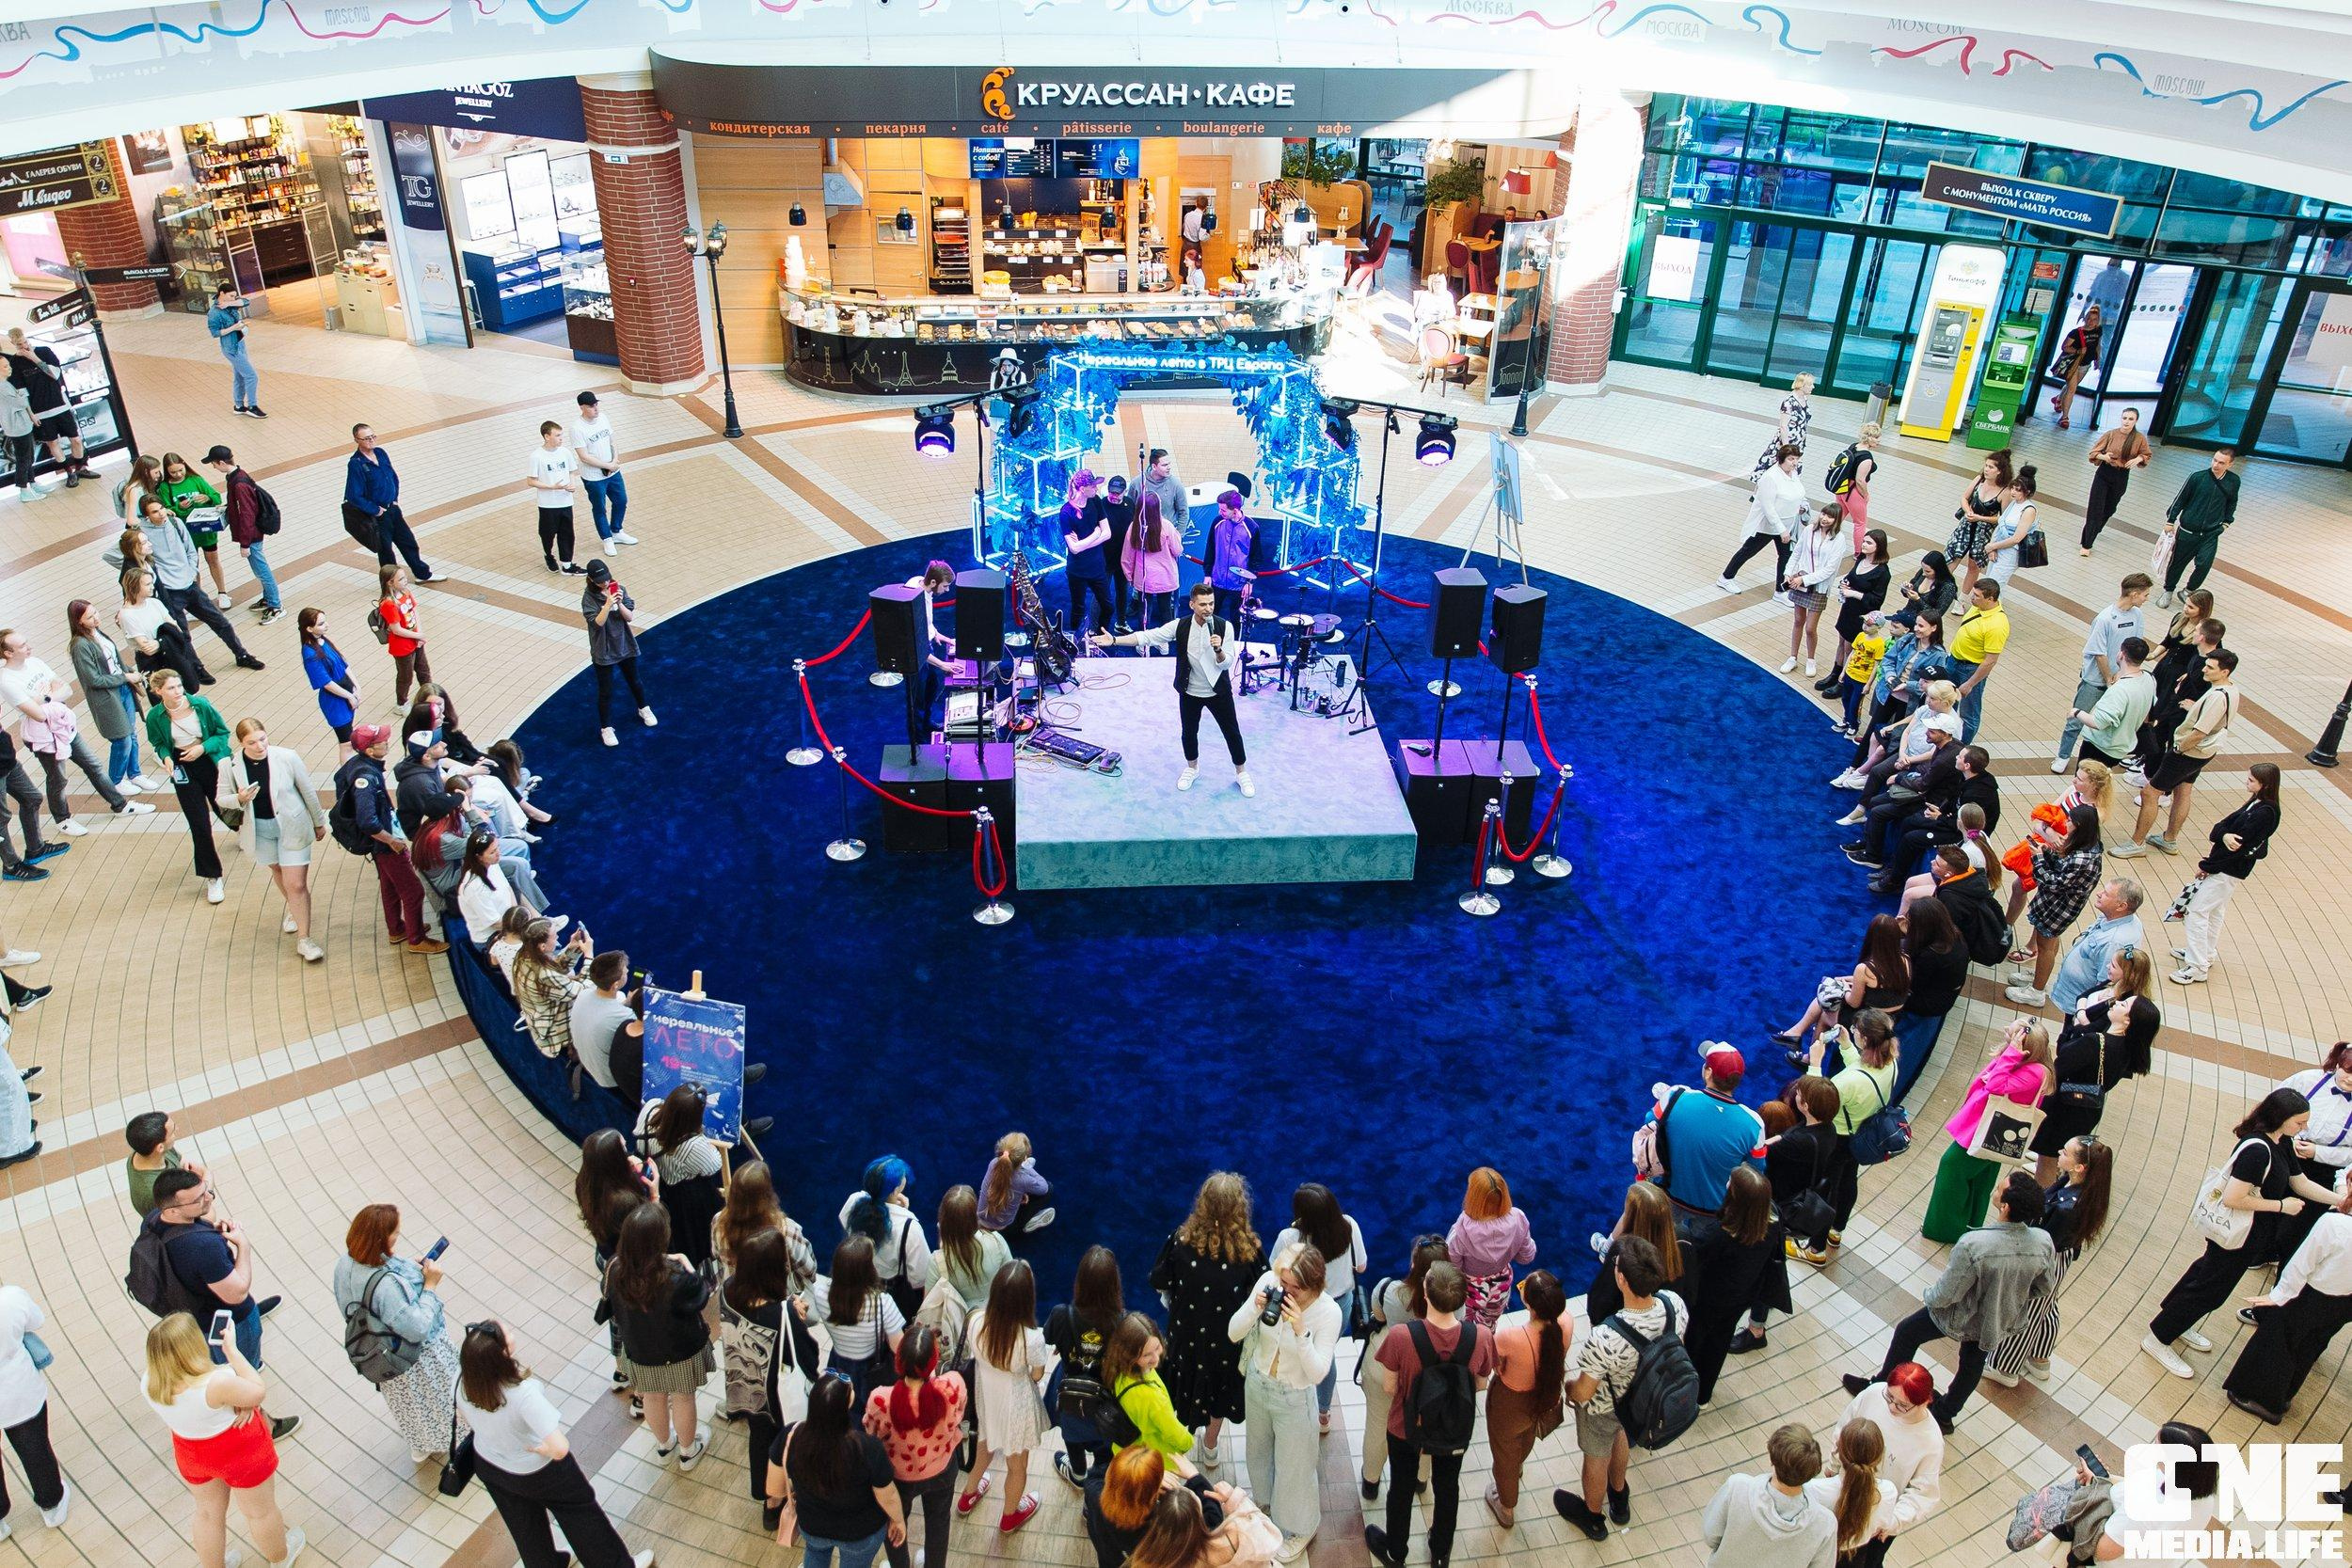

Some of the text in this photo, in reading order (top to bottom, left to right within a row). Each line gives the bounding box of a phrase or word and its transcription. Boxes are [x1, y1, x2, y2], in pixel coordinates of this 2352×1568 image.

[1645, 19, 1700, 38] МОСКВА
[454, 96, 493, 108] JEWELLERY
[1017, 82, 1295, 106] КРУАССАН КАФЕ
[709, 121, 811, 137] кондитерская
[866, 123, 927, 136] пекарня
[981, 121, 1009, 134] café
[1062, 121, 1132, 137] pâtisserie
[1184, 121, 1264, 137] boulangerie
[1317, 122, 1352, 137] кафе
[92, 155, 102, 167] 2
[25, 163, 83, 179] ГАЛЕРЕЯ ОБУВИ
[99, 179, 107, 190] 2
[401, 175, 432, 198] TG
[17, 188, 72, 207] М.видео
[1980, 182, 2058, 204] ВЫХОД К СКВЕРУ
[406, 199, 435, 209] JEWELLERY
[1943, 186, 2091, 223] С МОНУМЕНТОМ «МАТЬ РОССИЯ»
[1078, 352, 1284, 372] Нереальное лето в ТРЦ Европа
[1975, 420, 2010, 432] СБЕРБАНК
[653, 1014, 735, 1037] нереальное
[653, 1025, 737, 1060] ЛЕТО
